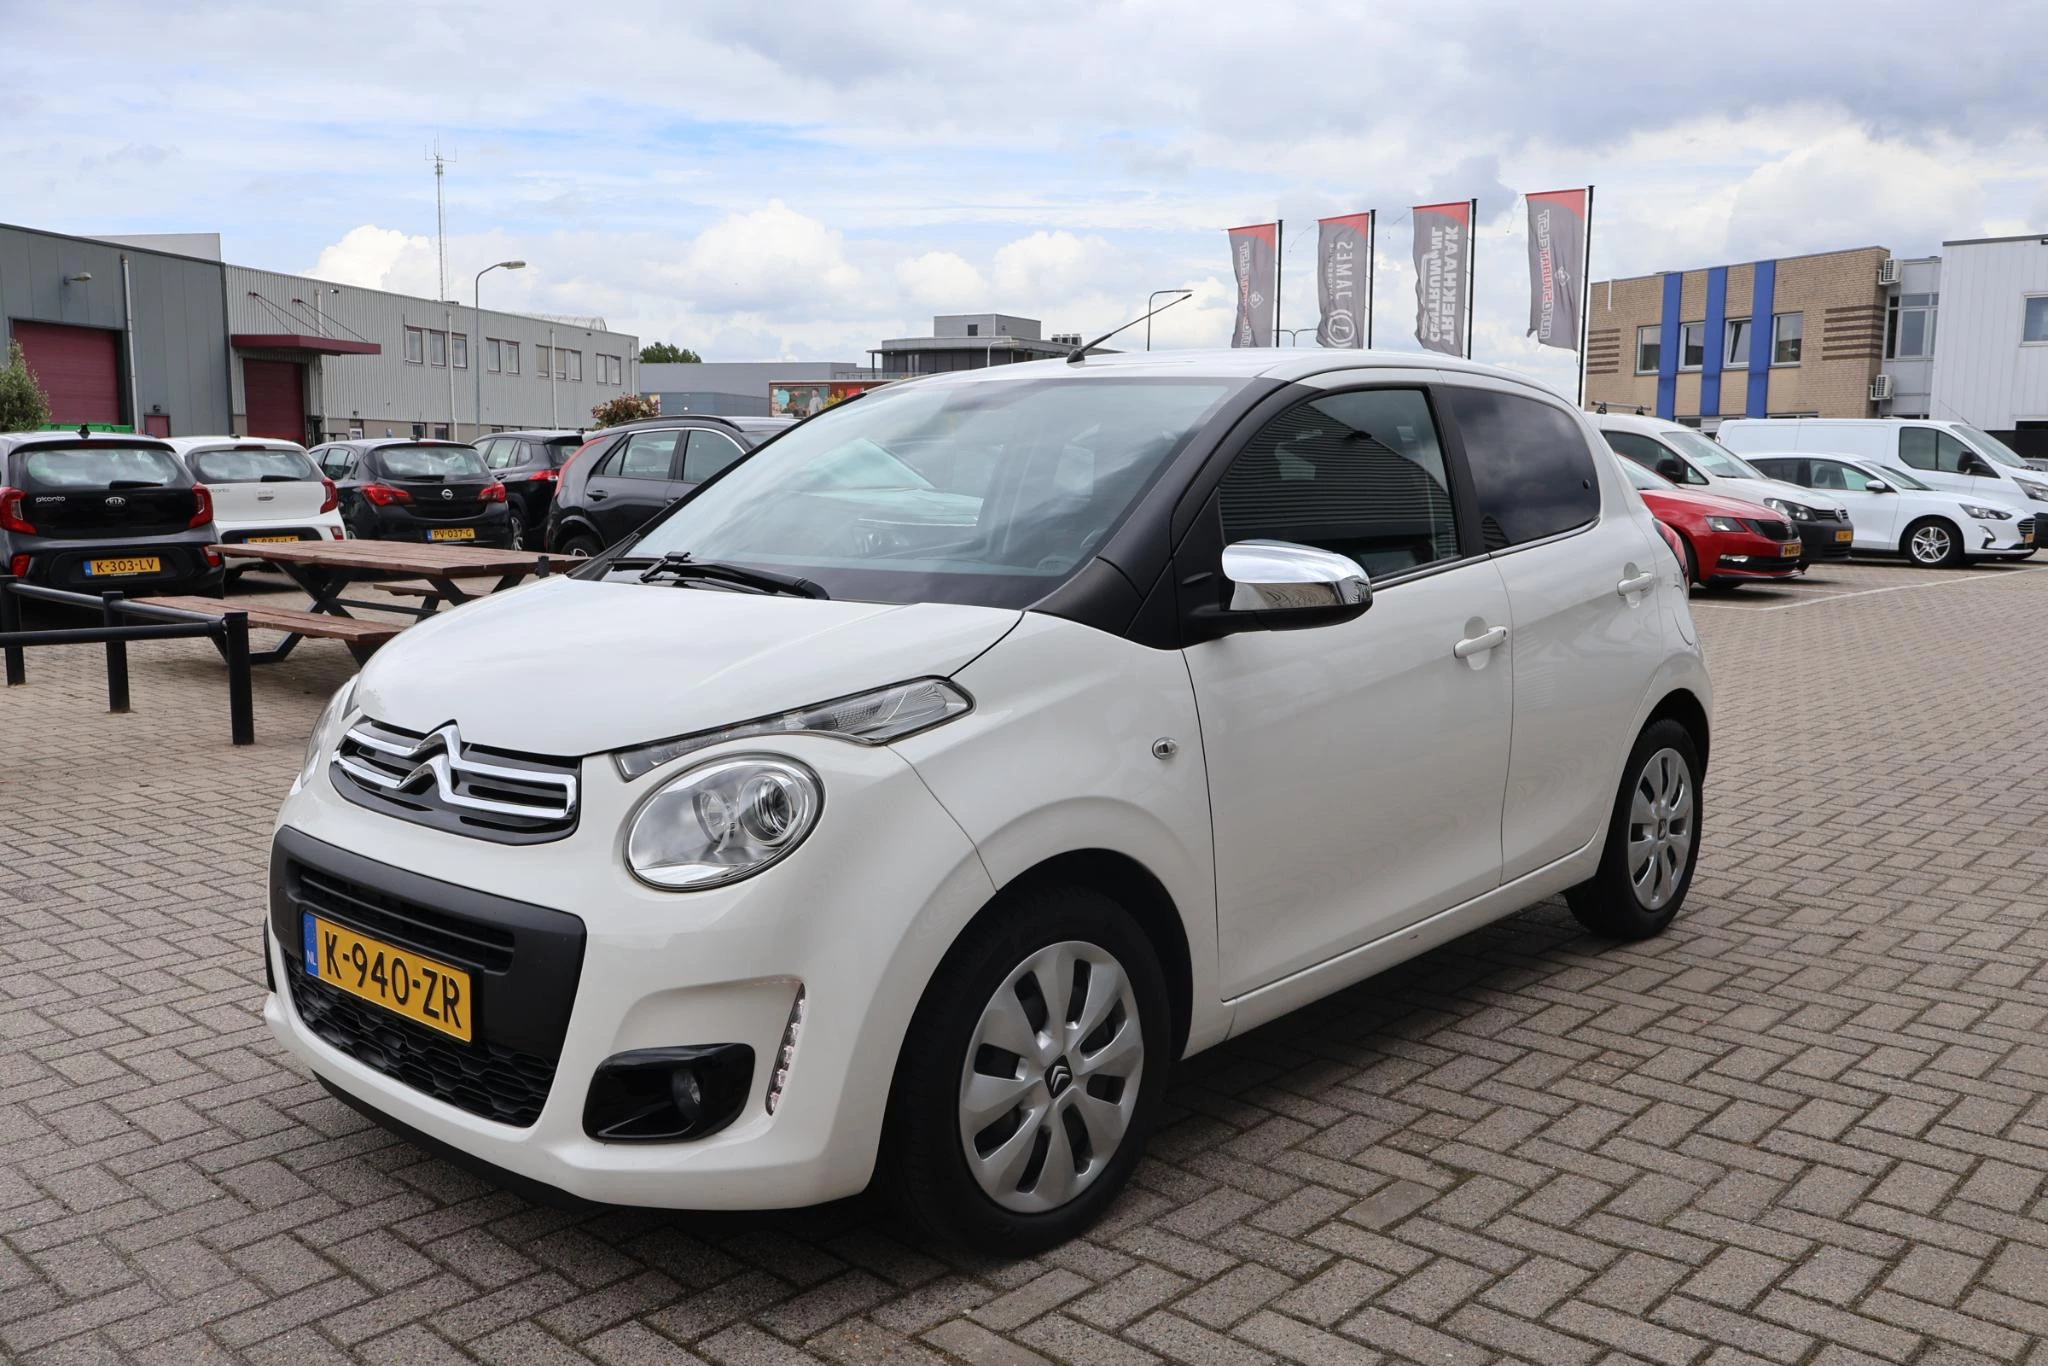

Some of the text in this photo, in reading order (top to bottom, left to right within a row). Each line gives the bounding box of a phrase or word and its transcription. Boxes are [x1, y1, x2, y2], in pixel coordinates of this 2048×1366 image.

[96, 559, 154, 573] K-303-LV
[306, 949, 318, 966] NL
[324, 930, 462, 1029] K-940-ZR
